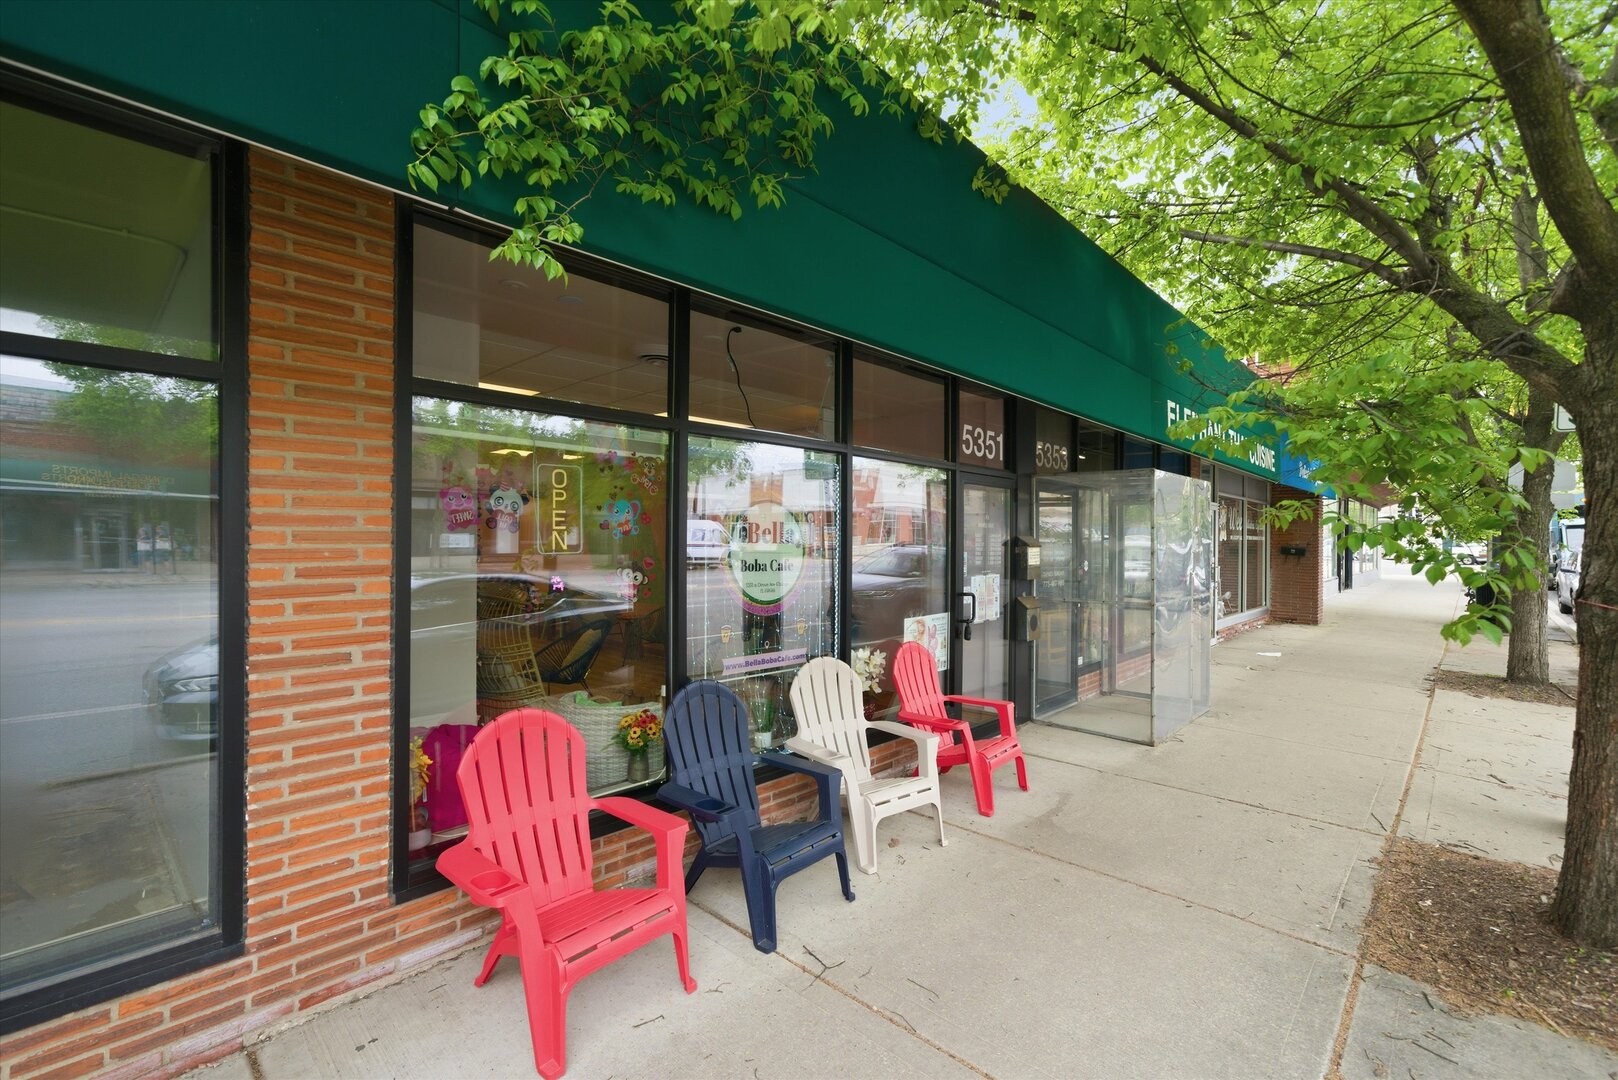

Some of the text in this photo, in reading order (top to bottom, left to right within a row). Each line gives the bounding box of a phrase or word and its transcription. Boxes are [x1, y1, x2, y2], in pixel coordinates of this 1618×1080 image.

[962, 424, 1004, 461] 5351
[1036, 441, 1068, 471] 5353
[552, 469, 568, 550] OPEN
[740, 558, 794, 572] Boba Cafe
